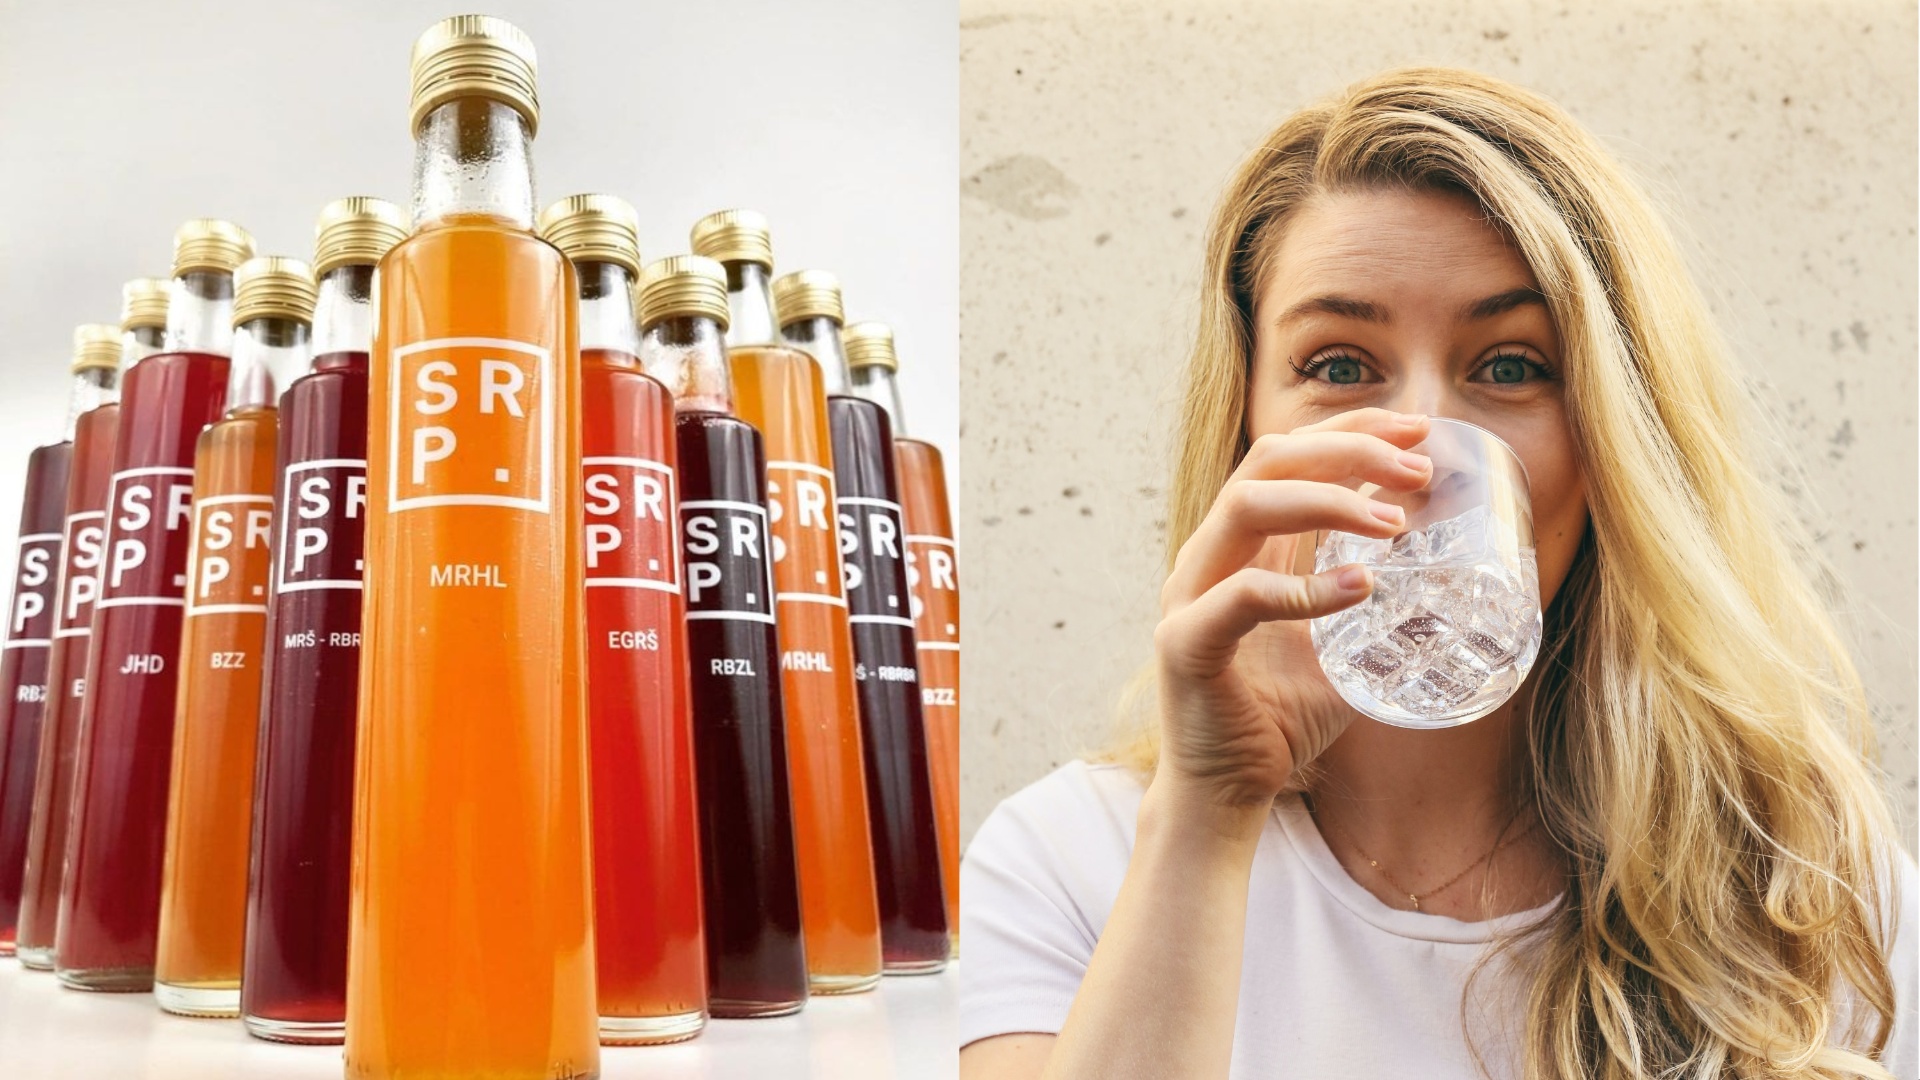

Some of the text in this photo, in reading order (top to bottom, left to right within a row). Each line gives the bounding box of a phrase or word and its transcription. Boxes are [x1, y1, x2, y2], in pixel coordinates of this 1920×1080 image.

[73, 527, 103, 569] S
[22, 548, 50, 586] S
[430, 564, 507, 588] MRHL
[67, 575, 98, 620] P
[15, 592, 44, 632] P
[285, 629, 316, 649] MRŠ
[330, 632, 361, 647] RBR
[608, 629, 659, 651] EGRŠ
[120, 654, 164, 674] JHD
[210, 652, 245, 669] BZZ
[711, 658, 755, 676] RBZL
[17, 684, 46, 702] RBZ
[922, 688, 956, 706] BZZ
